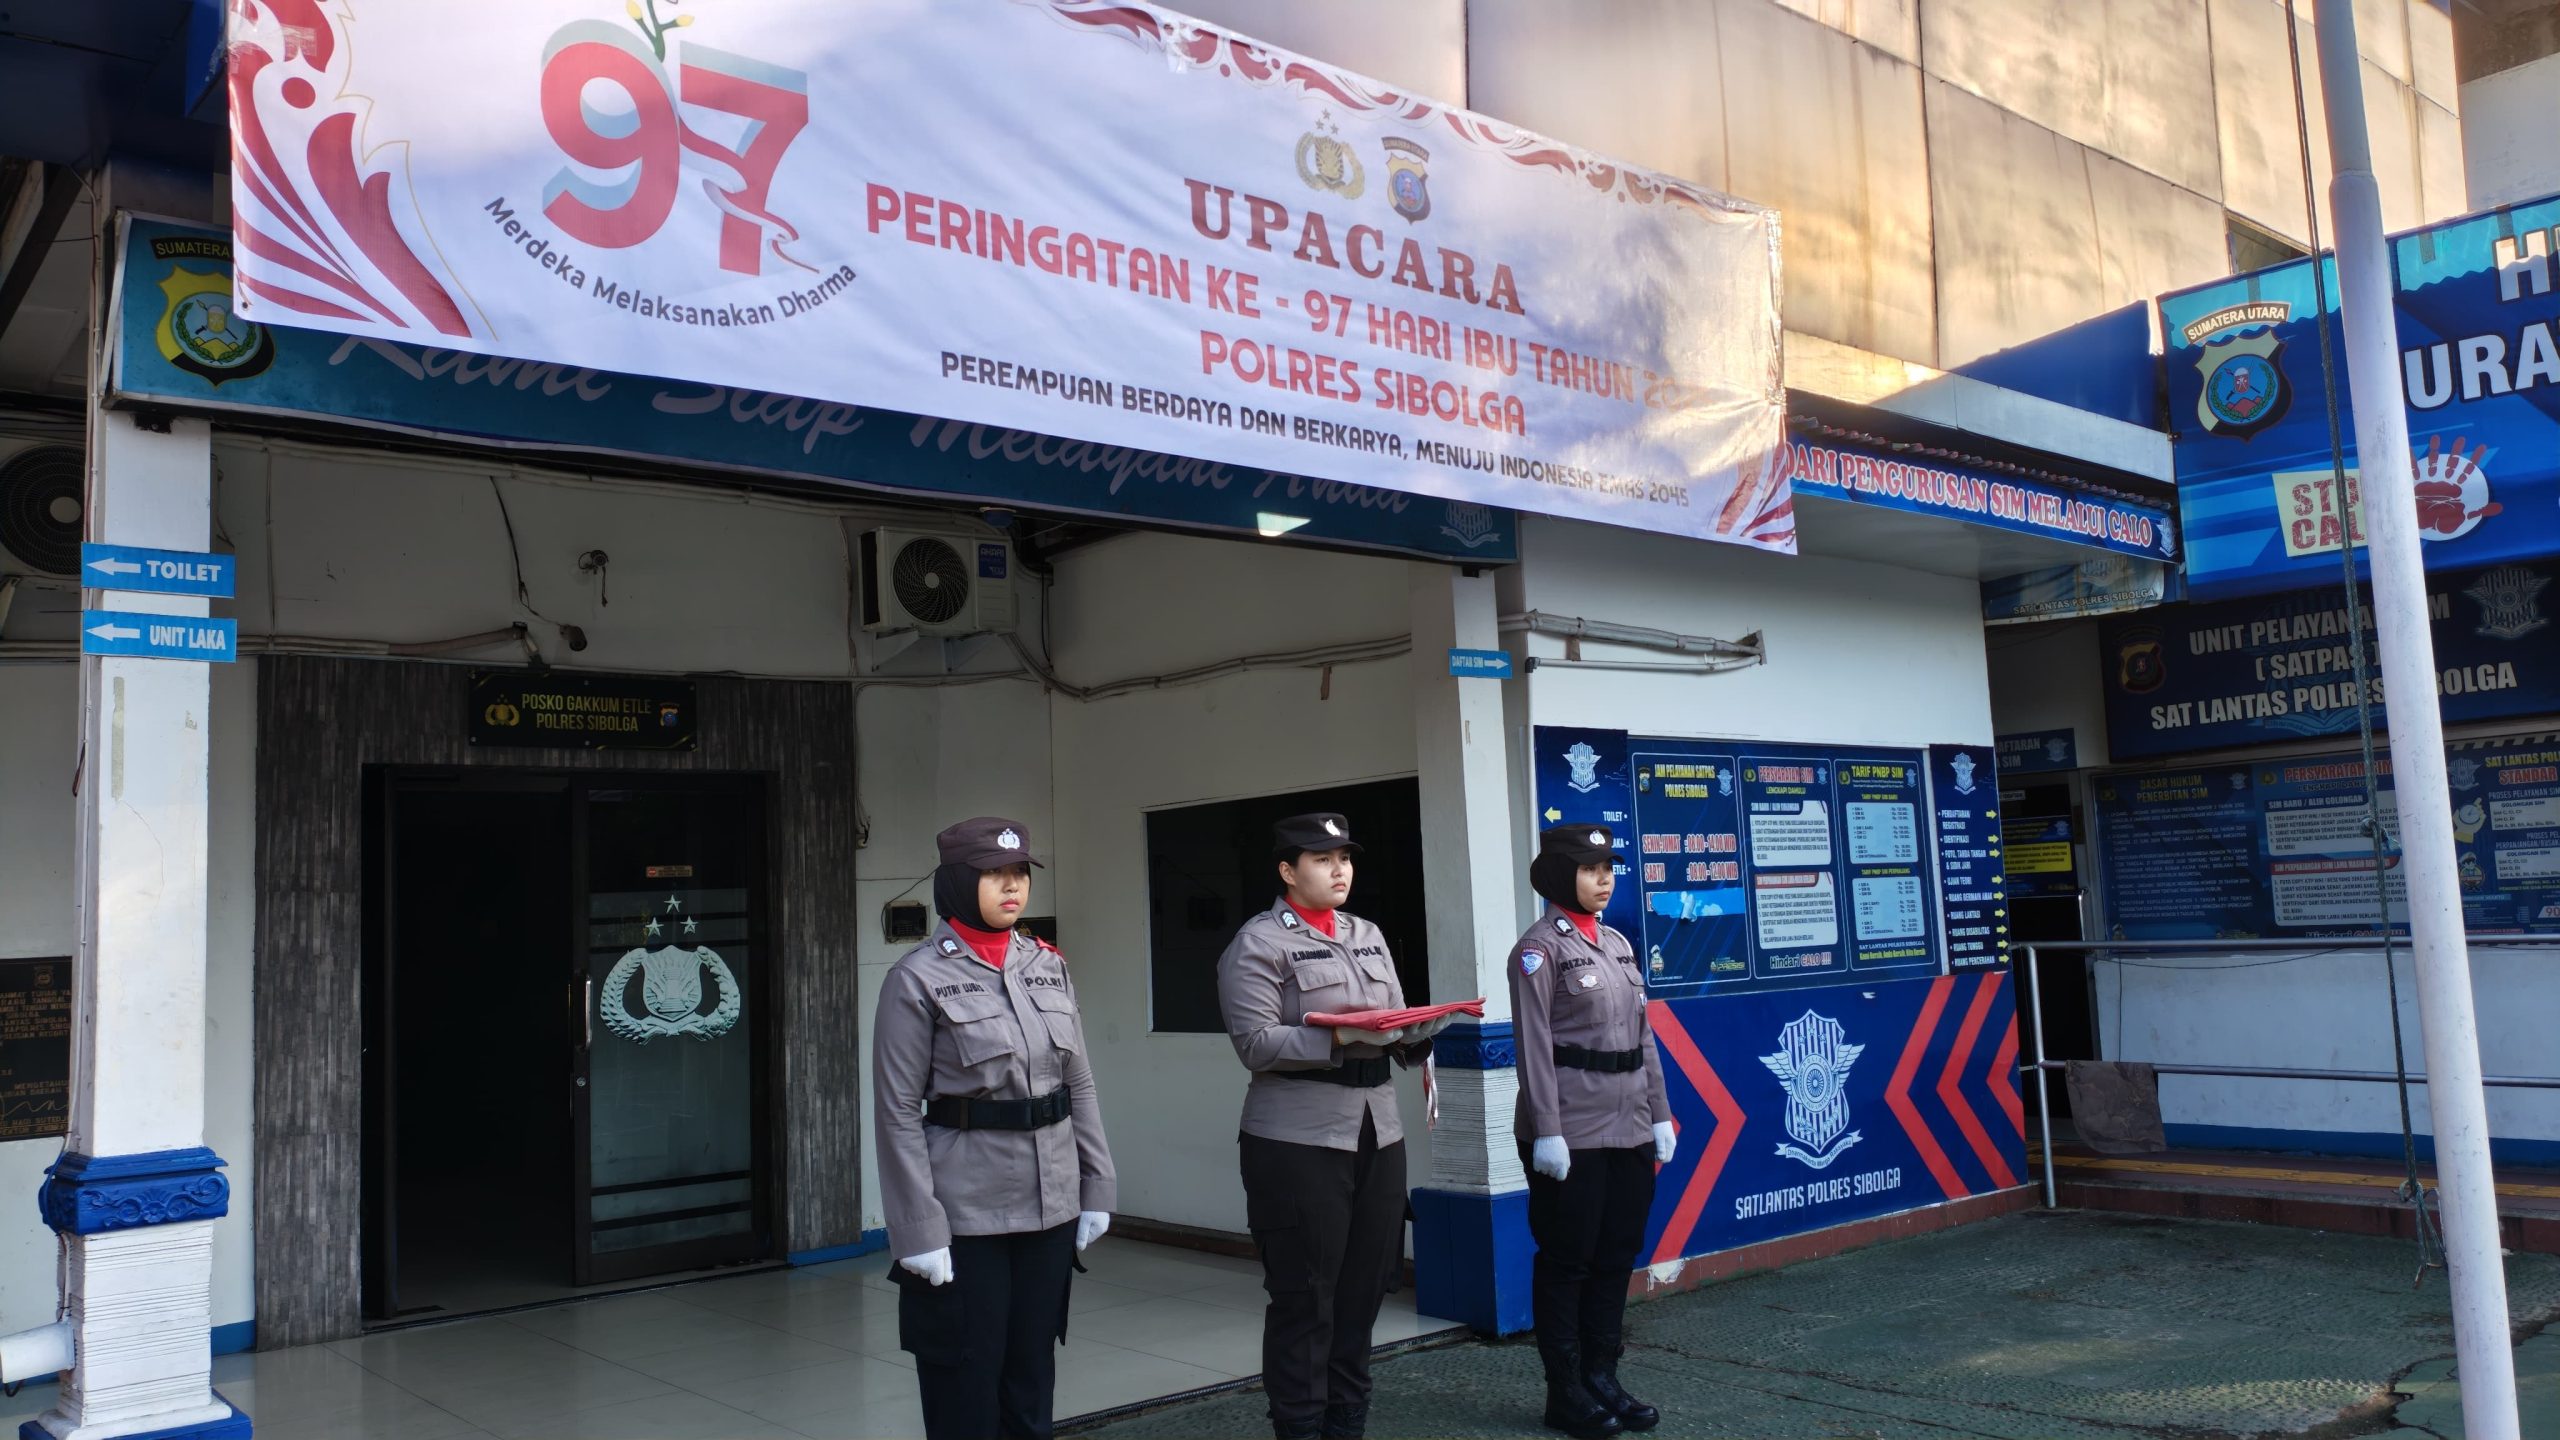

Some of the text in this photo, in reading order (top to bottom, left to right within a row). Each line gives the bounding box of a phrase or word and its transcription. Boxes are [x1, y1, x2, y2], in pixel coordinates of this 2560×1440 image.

[541, 18, 809, 276] 97
[156, 241, 230, 258] SUMATERA
[1184, 177, 1525, 316] UPACARA
[483, 197, 857, 327] Merdeka Melaksanakan Dharma
[866, 182, 1191, 304] PERINGATAN
[1206, 265, 1260, 318] KE
[1304, 290, 1351, 337] 97
[1367, 303, 1452, 360] HARI
[1464, 327, 1518, 376] IBU
[1529, 341, 1633, 404] TAHUN
[2187, 305, 2286, 341] SUMATERA UTARA
[1200, 329, 1526, 437] POLRES SIBOLGA
[940, 350, 1689, 508] PEREMPUAN BERDAYA DAN BERKARYA, MENUJU INDONESIA EMAS 2045
[1840, 452, 1988, 514] PENGURUSAN
[1989, 483, 2026, 521] SIM
[2027, 490, 2109, 540] MELALUI
[2108, 508, 2153, 549] CALO
[146, 559, 222, 583] TOILET
[2012, 588, 2155, 616] SAT LANTAS POLRES SIBOLGA
[149, 624, 227, 651] UNIT LAKA
[2189, 624, 2245, 656] UNIT
[521, 692, 652, 715] POSKO GAKKUM ETLE
[2150, 702, 2193, 730] SAT
[2196, 688, 2289, 725] LANTAS
[536, 712, 640, 732] POLRES SIBOLGA
[2484, 755, 2502, 768] SAT
[2503, 753, 2539, 767] LANTAS
[1801, 767, 1814, 784] SIM
[1851, 765, 1904, 778] TARIF PNBP SIM
[2284, 762, 2365, 784] PERSYARATAN
[2498, 766, 2558, 785] STANDAR
[2140, 774, 2203, 791] DASAR HUKUM
[2137, 787, 2208, 803] PENERBITAN SIM
[2268, 799, 2282, 809] SIM
[2283, 799, 2302, 808] BARU
[2325, 794, 2363, 805] GOLONGAN
[2488, 791, 2512, 801] PROSES
[2512, 787, 2548, 799] PELAYANAN
[2501, 801, 2533, 809] GOLONGAN
[1602, 811, 1623, 822] TOILET
[2526, 832, 2548, 840] PROSES
[1644, 863, 1666, 882] SABTU
[1948, 893, 1962, 901] RUANG
[1950, 911, 1964, 919] RUANG
[1952, 928, 1966, 936] RUANG
[1560, 957, 1595, 972] RIZKA
[1770, 953, 1801, 969] Hindari
[1801, 953, 1821, 967] CALO
[935, 984, 961, 998] PUTRI
[1024, 976, 1063, 988] POLRI
[1735, 1167, 1901, 1220] SATLANTAS POLRES SIBOLGA
